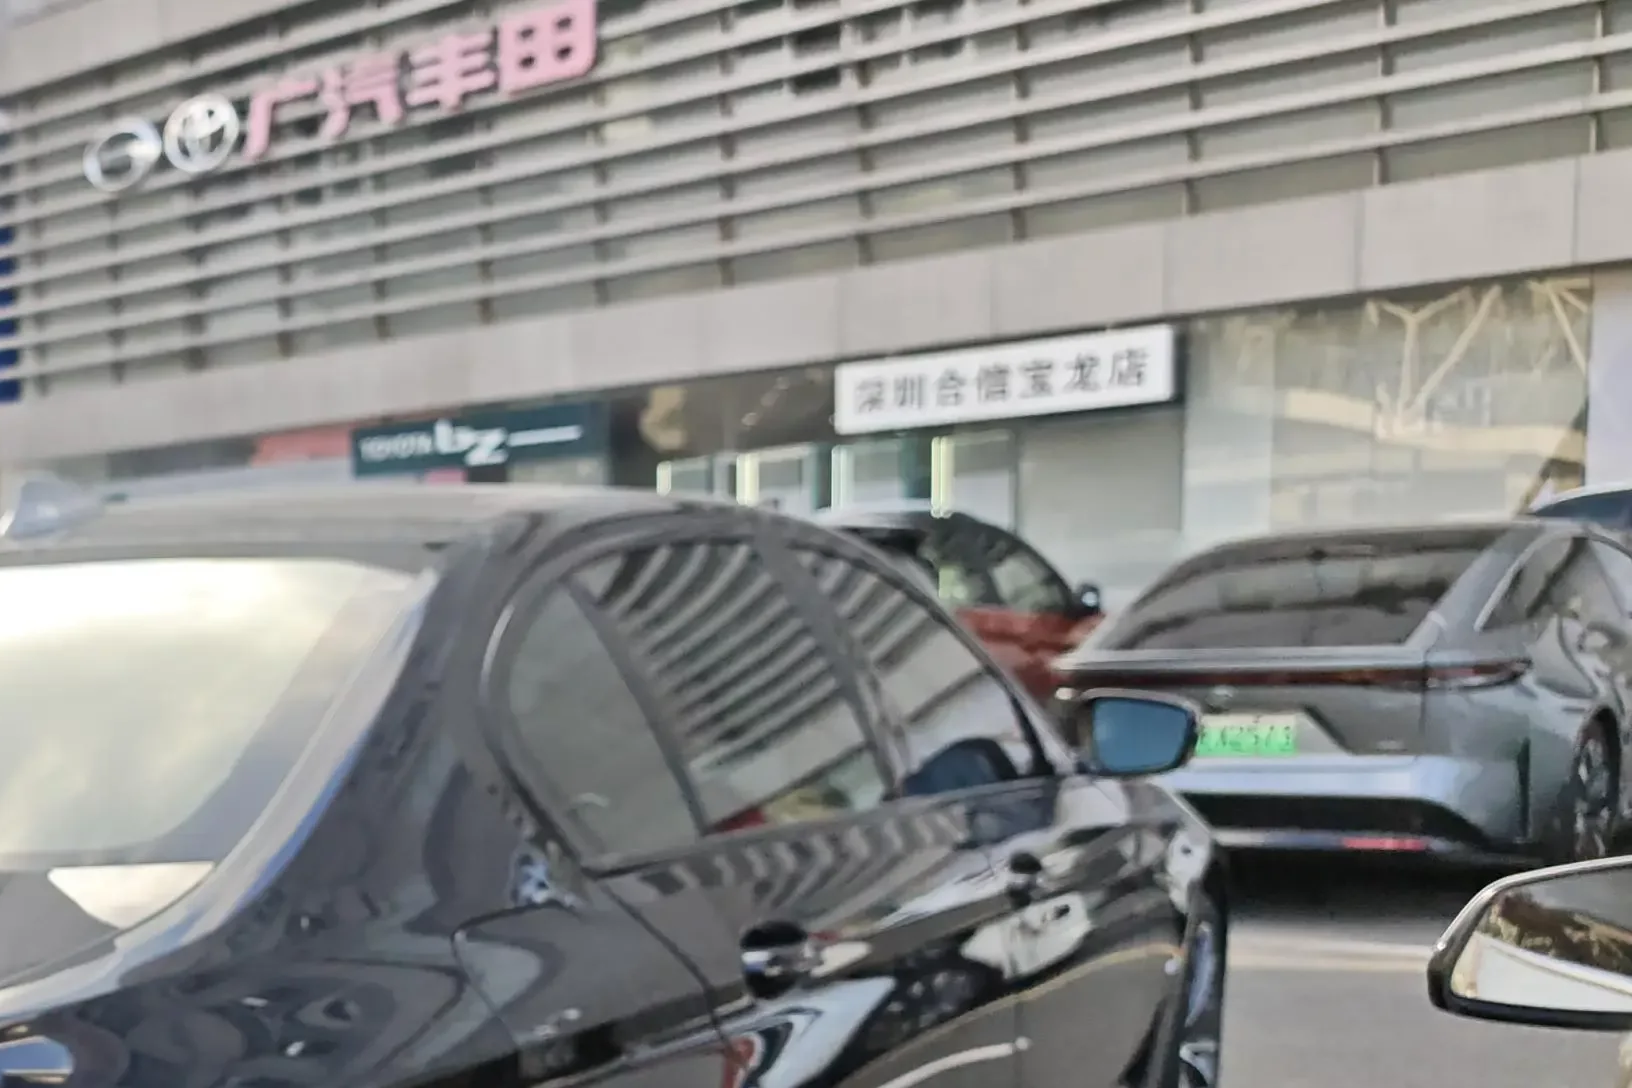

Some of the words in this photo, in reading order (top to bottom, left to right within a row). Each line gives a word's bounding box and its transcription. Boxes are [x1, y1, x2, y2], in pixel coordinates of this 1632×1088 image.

[241, 0, 597, 165] 广汽丰田
[854, 349, 1149, 414] 深圳合信宝龙店
